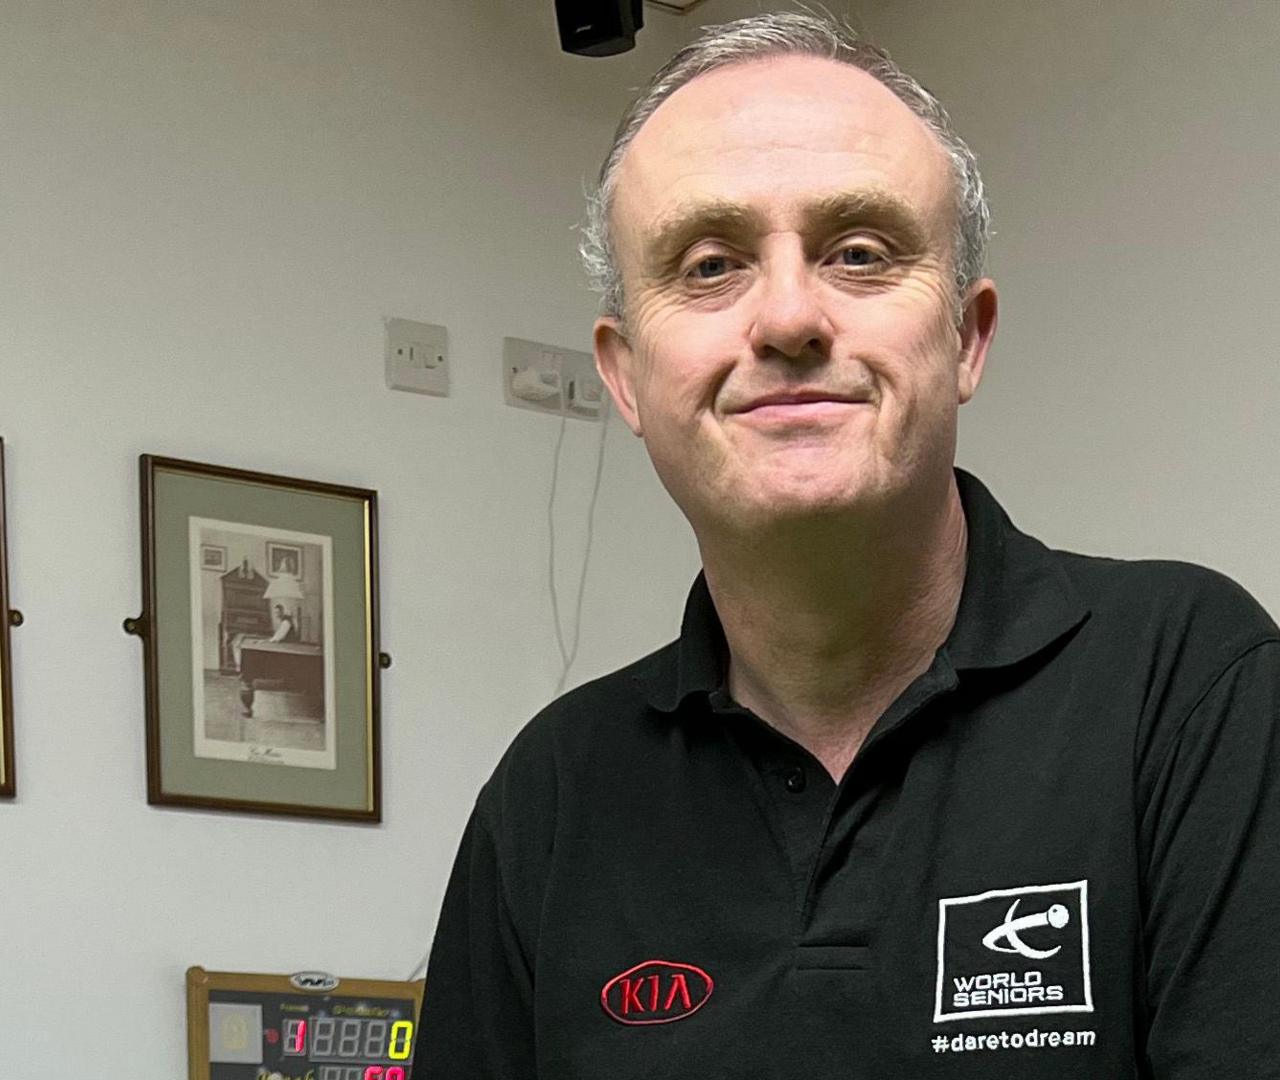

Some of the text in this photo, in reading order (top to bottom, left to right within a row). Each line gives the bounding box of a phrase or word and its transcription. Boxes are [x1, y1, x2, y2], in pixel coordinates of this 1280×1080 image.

[953, 970, 1042, 992] WORLD
[620, 973, 693, 1015] KIA
[953, 985, 1064, 1008] SENIORS
[931, 1029, 1096, 1054] #daretodream
